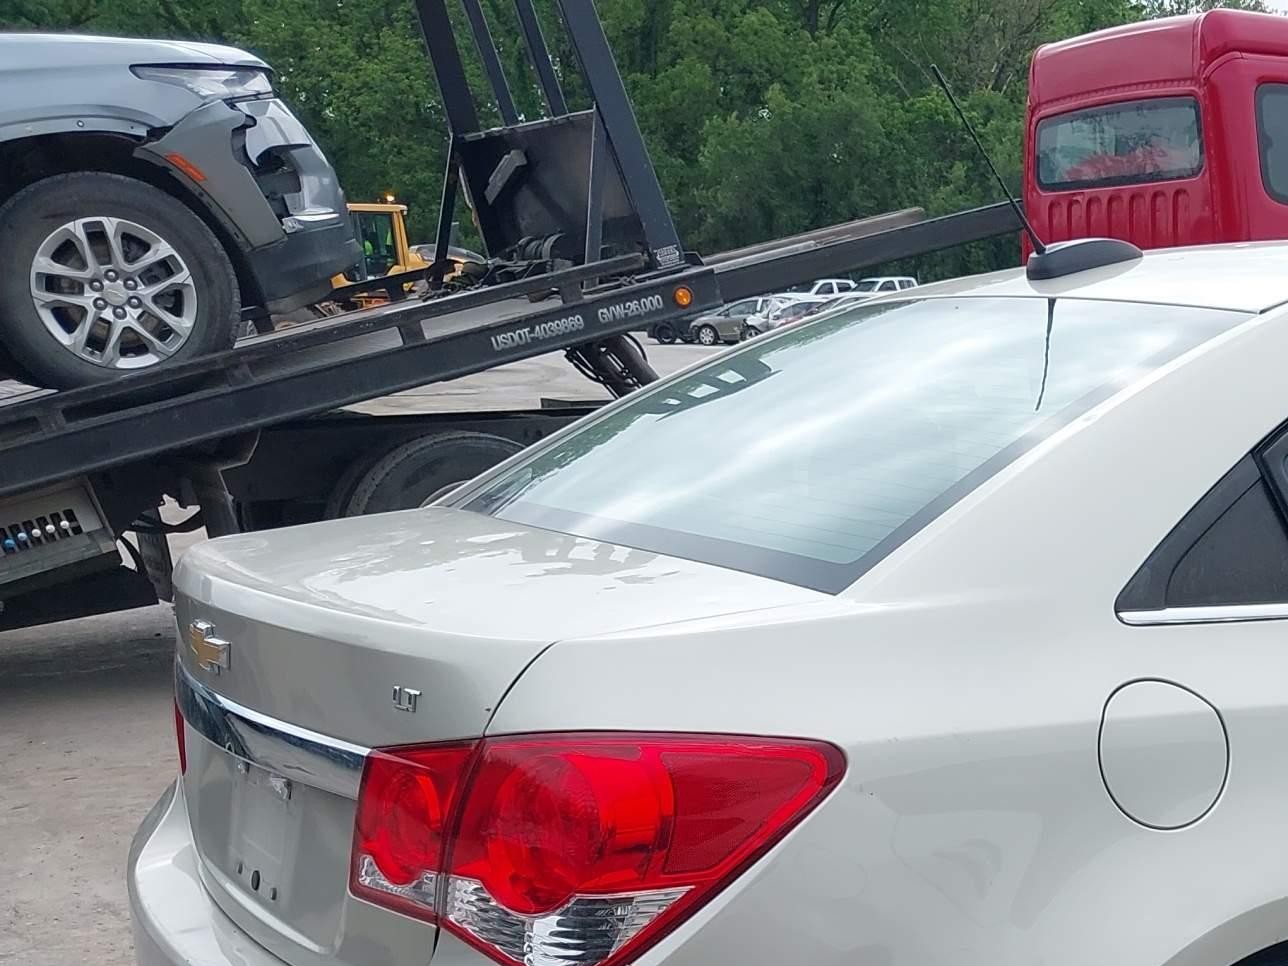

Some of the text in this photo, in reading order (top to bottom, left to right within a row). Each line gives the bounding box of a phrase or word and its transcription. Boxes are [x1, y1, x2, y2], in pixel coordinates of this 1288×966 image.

[490, 294, 664, 352] USDOT-4039869 GVW-26,000
[392, 685, 422, 713] LT
